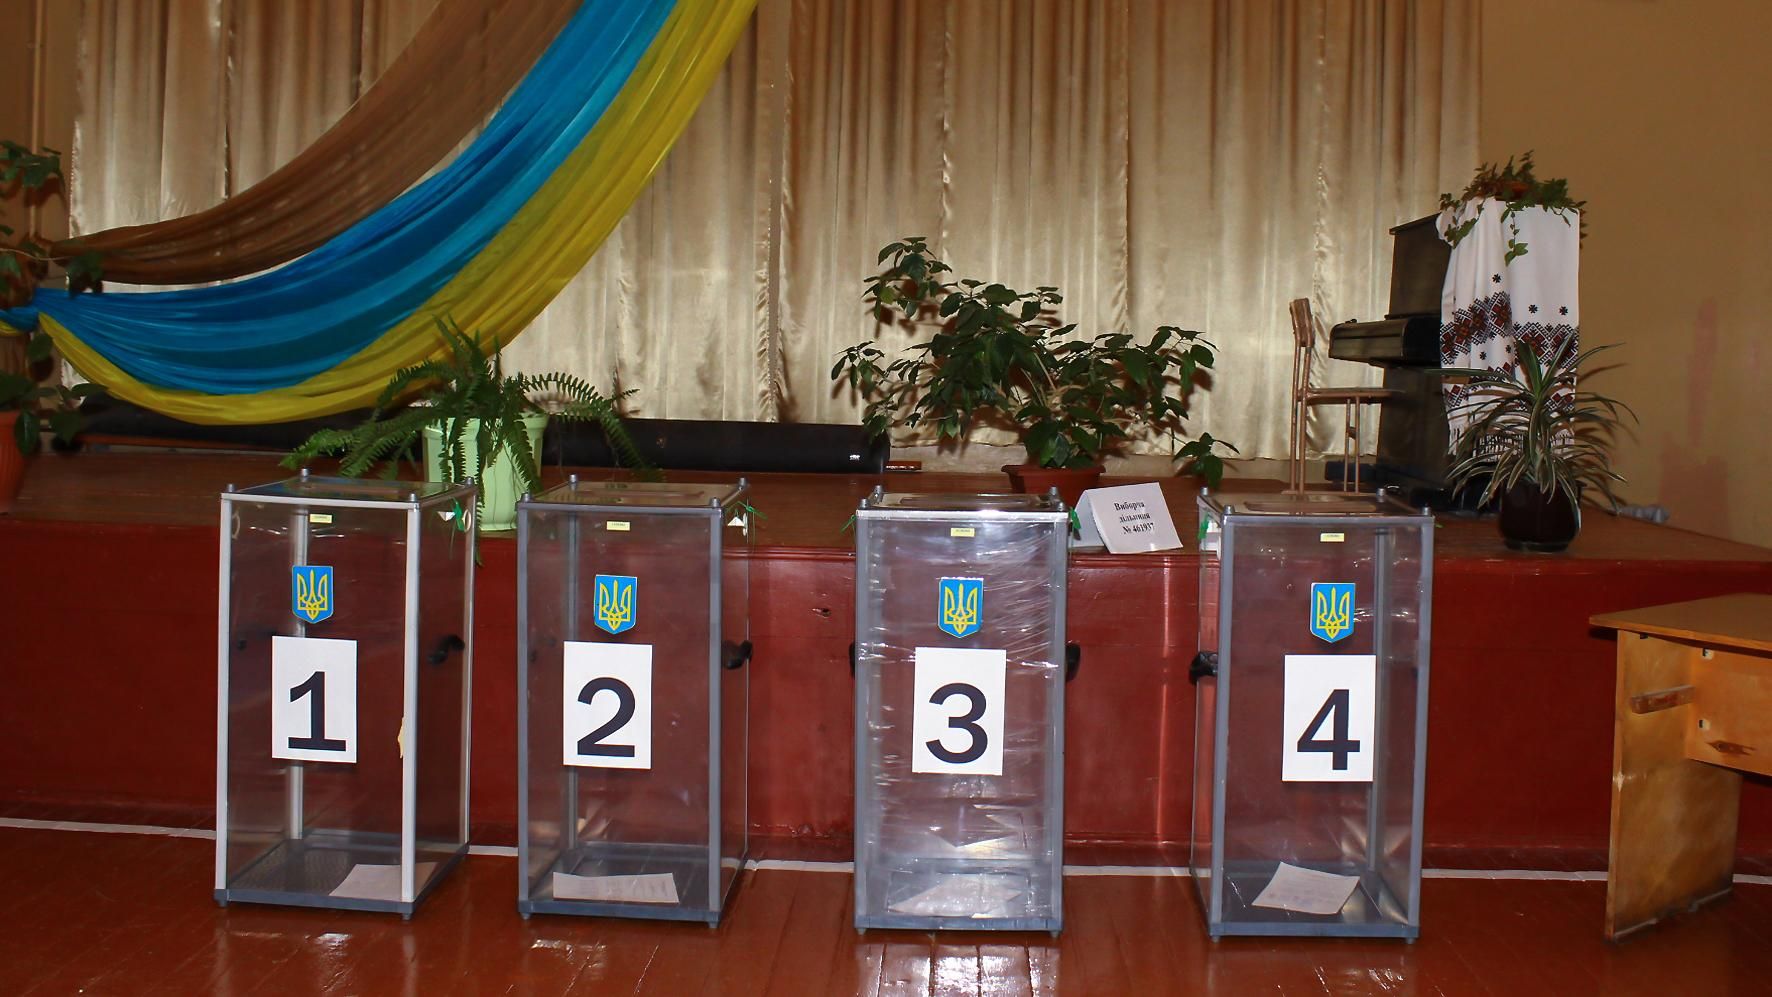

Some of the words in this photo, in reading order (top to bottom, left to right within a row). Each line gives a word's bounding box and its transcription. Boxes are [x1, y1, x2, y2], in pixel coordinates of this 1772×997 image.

[1114, 501, 1145, 511] Виборча
[288, 672, 346, 751] 1
[578, 678, 635, 757] 2
[926, 683, 987, 763] 3
[1297, 690, 1360, 770] 4
